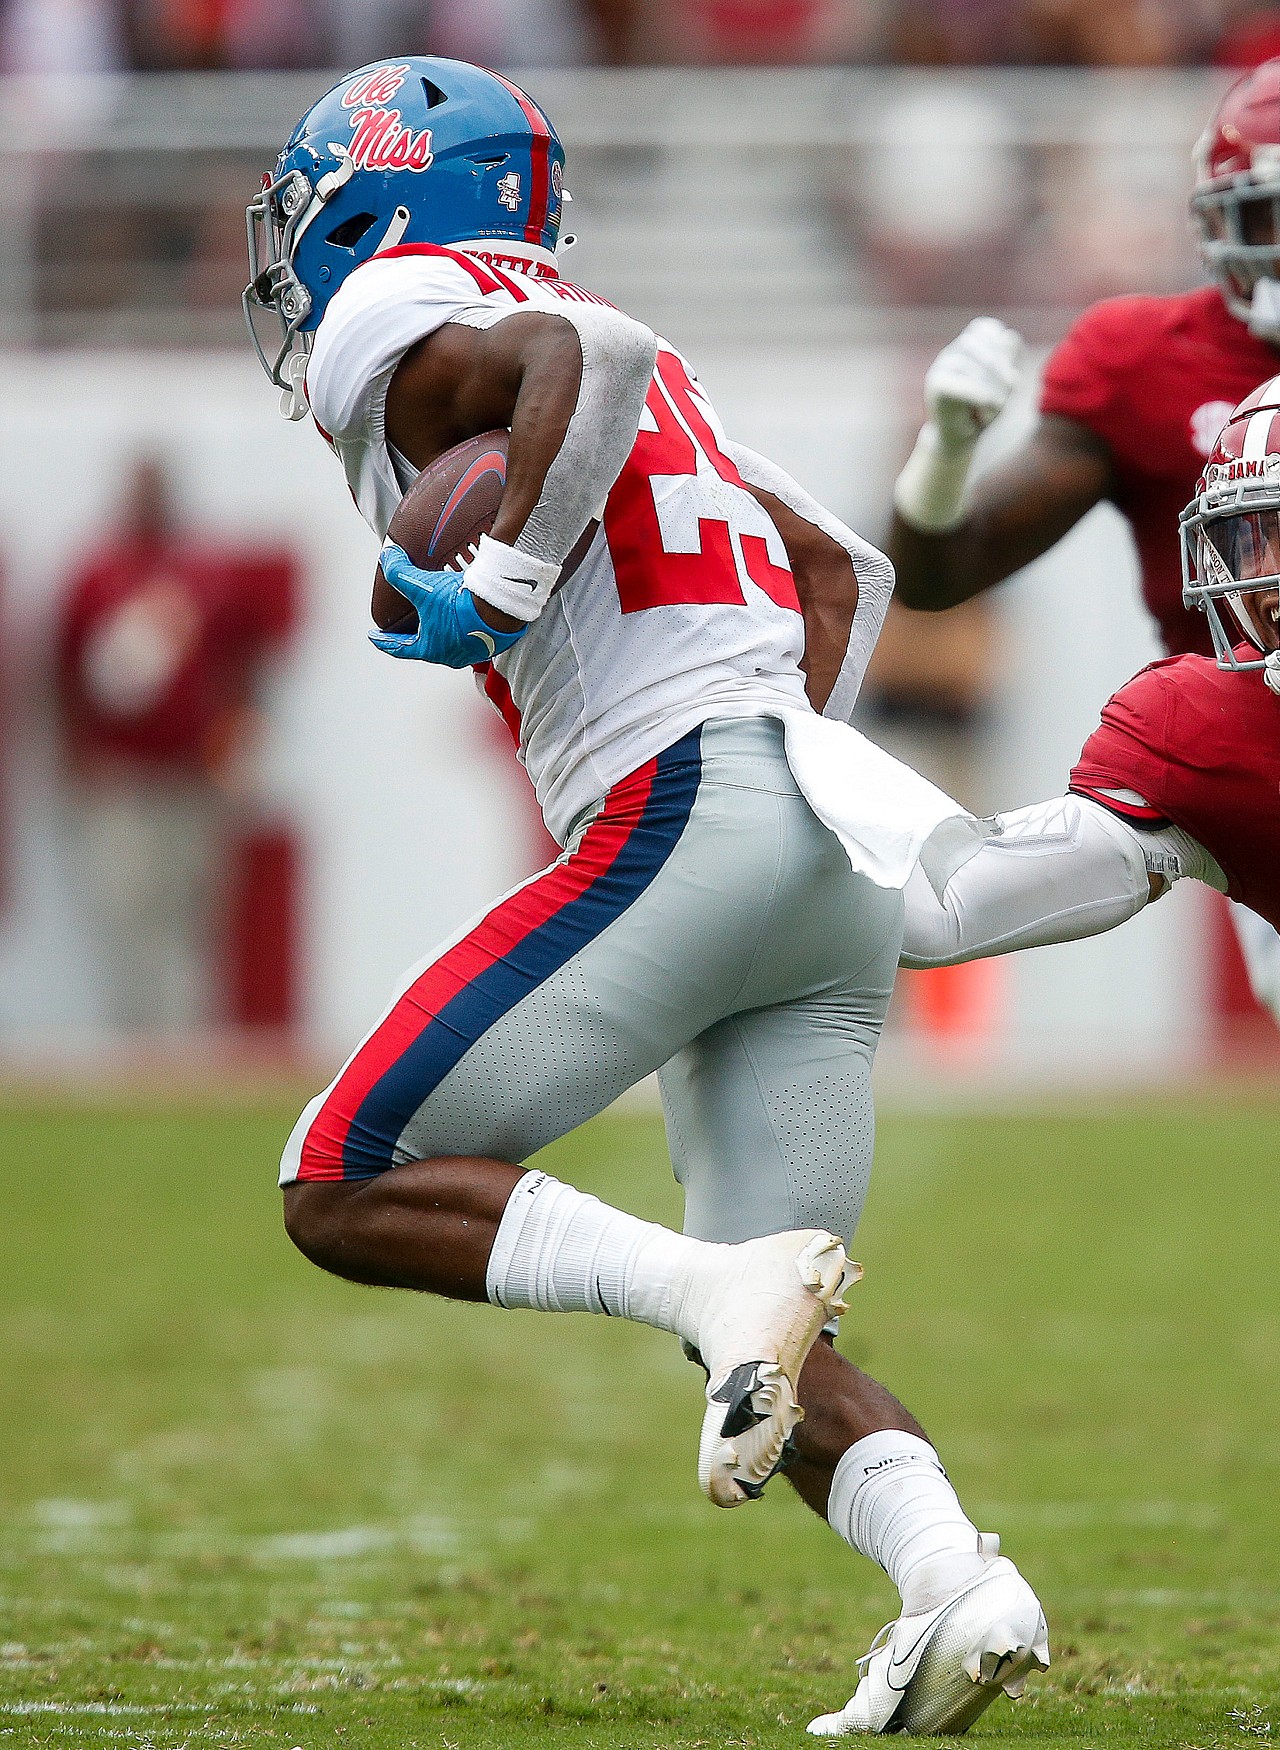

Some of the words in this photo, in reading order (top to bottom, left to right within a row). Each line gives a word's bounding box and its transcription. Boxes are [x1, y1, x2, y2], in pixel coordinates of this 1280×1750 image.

[342, 65, 410, 108] Ole
[349, 107, 434, 172] Miss
[462, 249, 533, 275] OTTY
